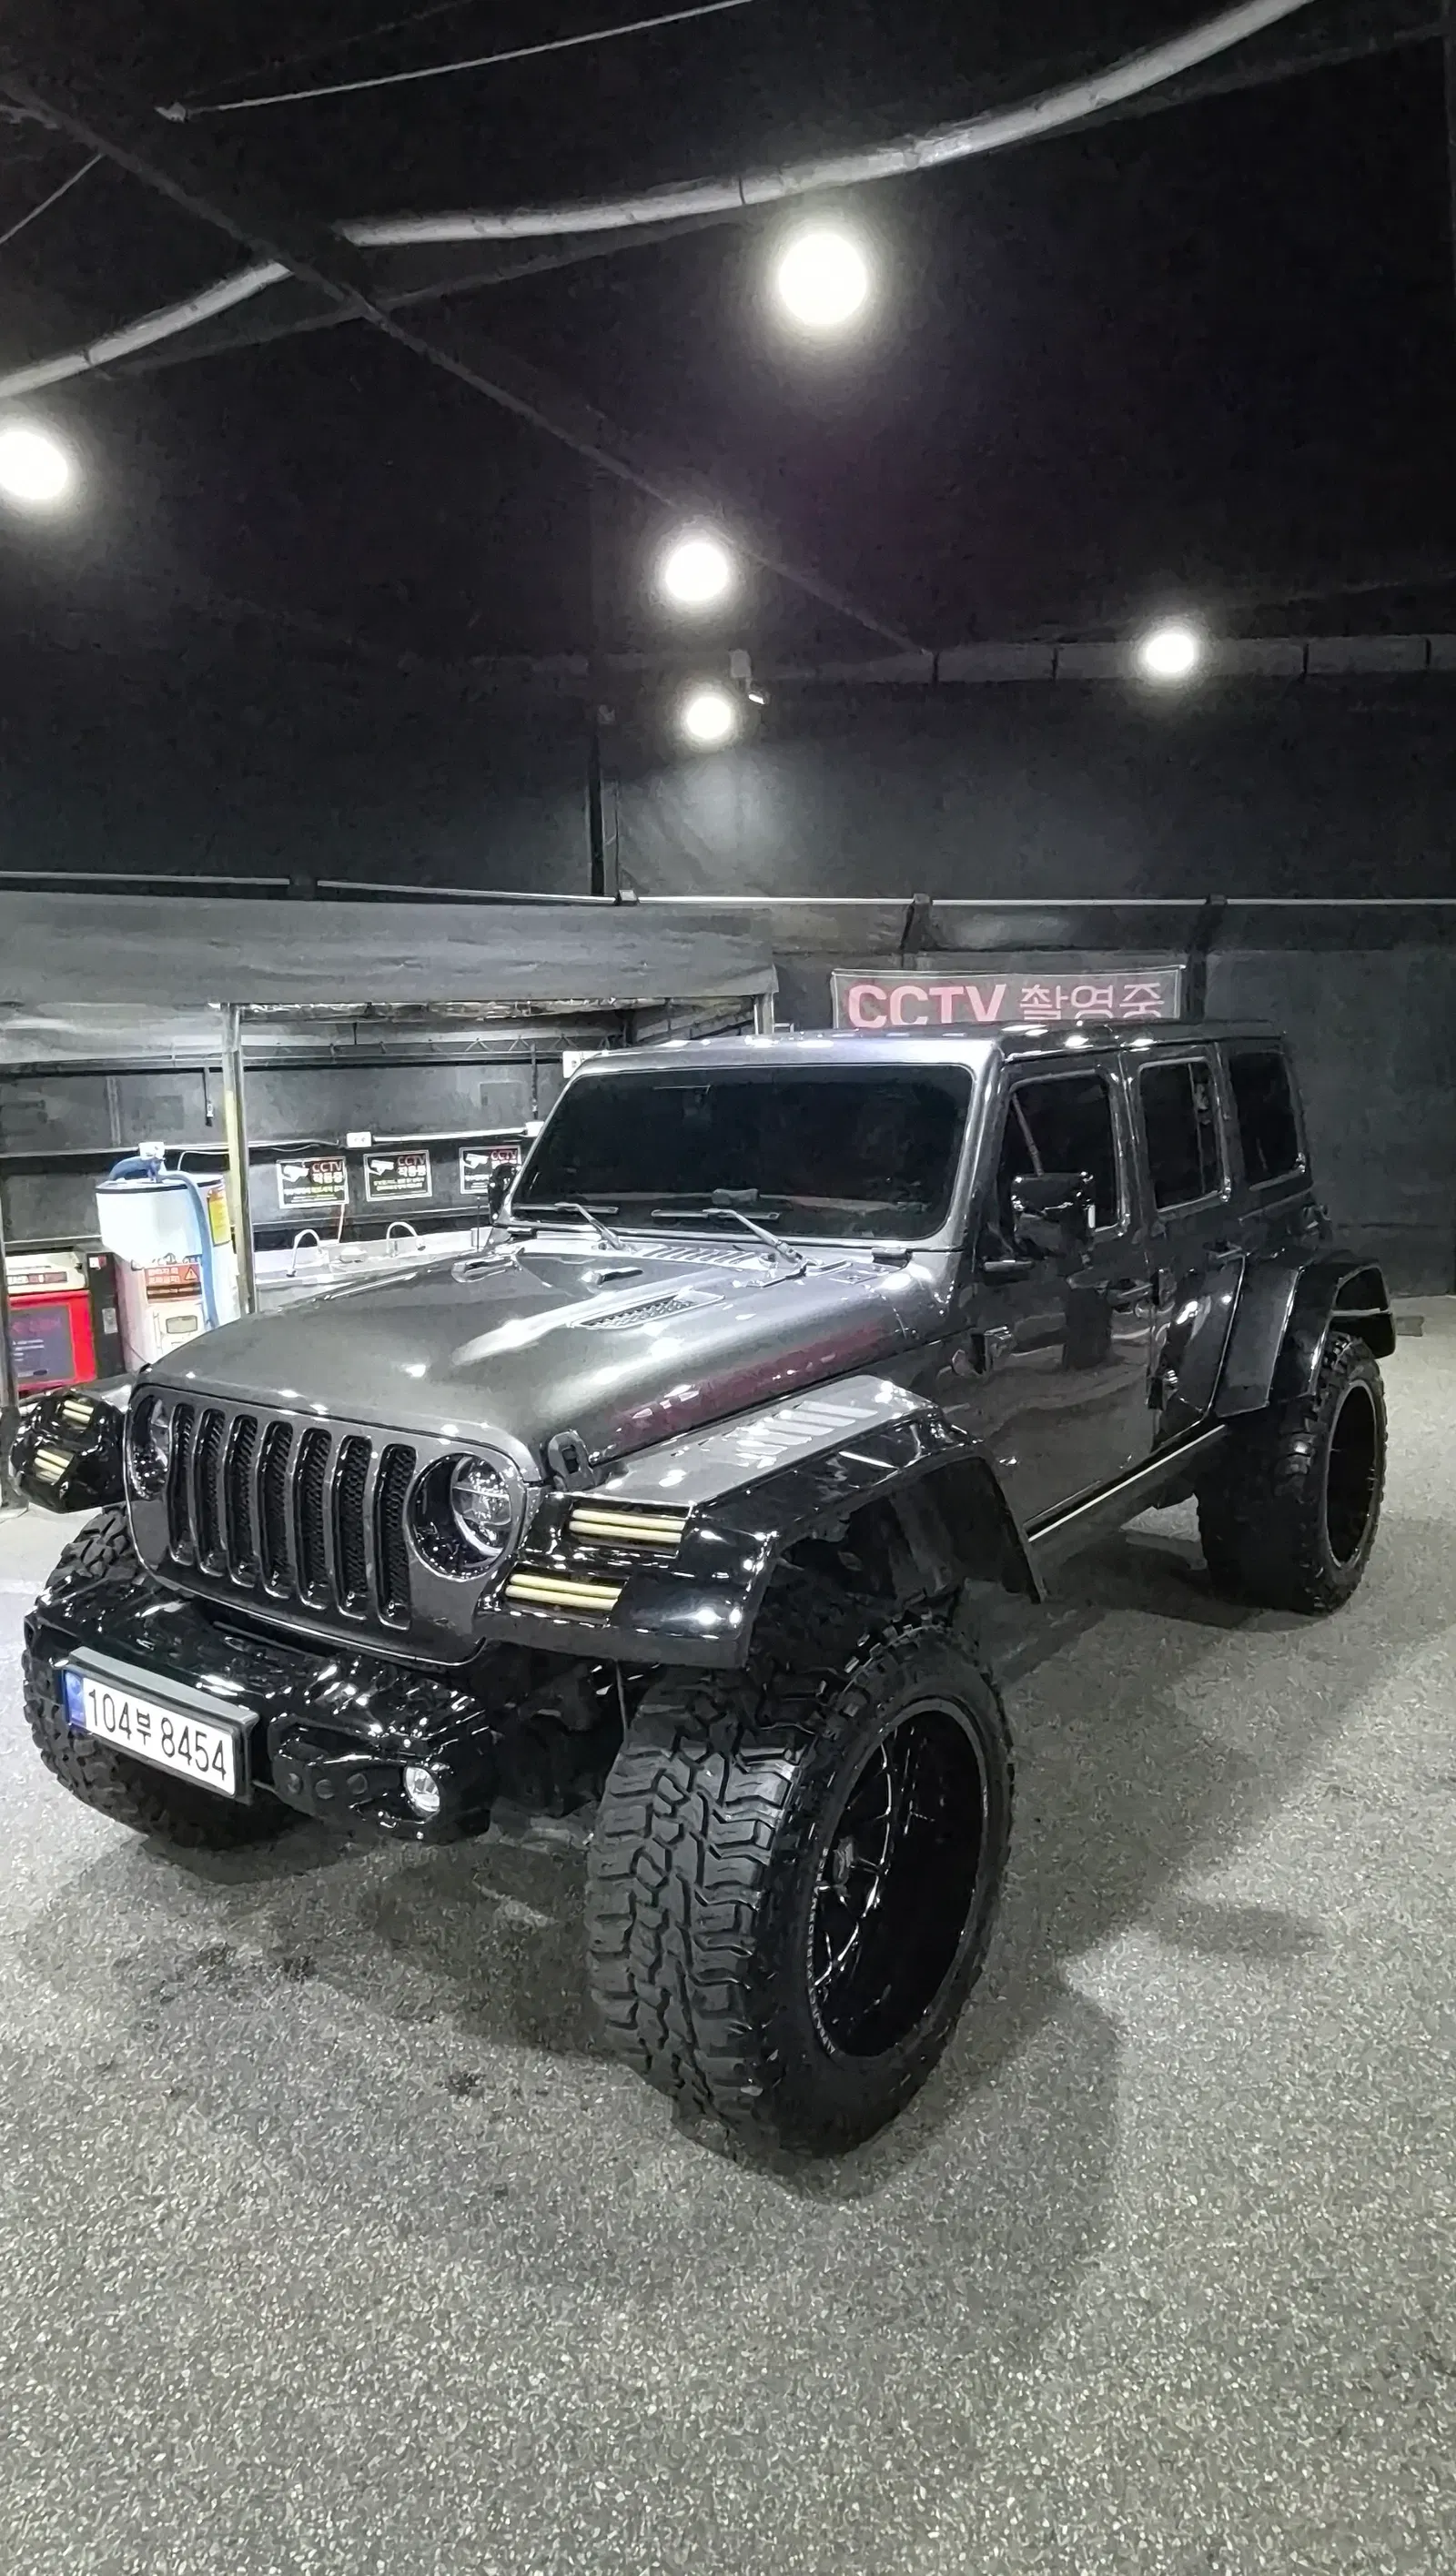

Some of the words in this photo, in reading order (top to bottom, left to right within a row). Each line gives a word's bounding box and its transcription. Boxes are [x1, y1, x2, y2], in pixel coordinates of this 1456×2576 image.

[848, 984, 1006, 1028] CCTV
[1020, 982, 1165, 1020] 촬영중
[398, 1155, 426, 1166] CCTV
[491, 1150, 518, 1160] CCTV
[312, 1161, 342, 1172] CCTV
[88, 1689, 151, 1745] 104부
[161, 1717, 227, 1781] 8454
